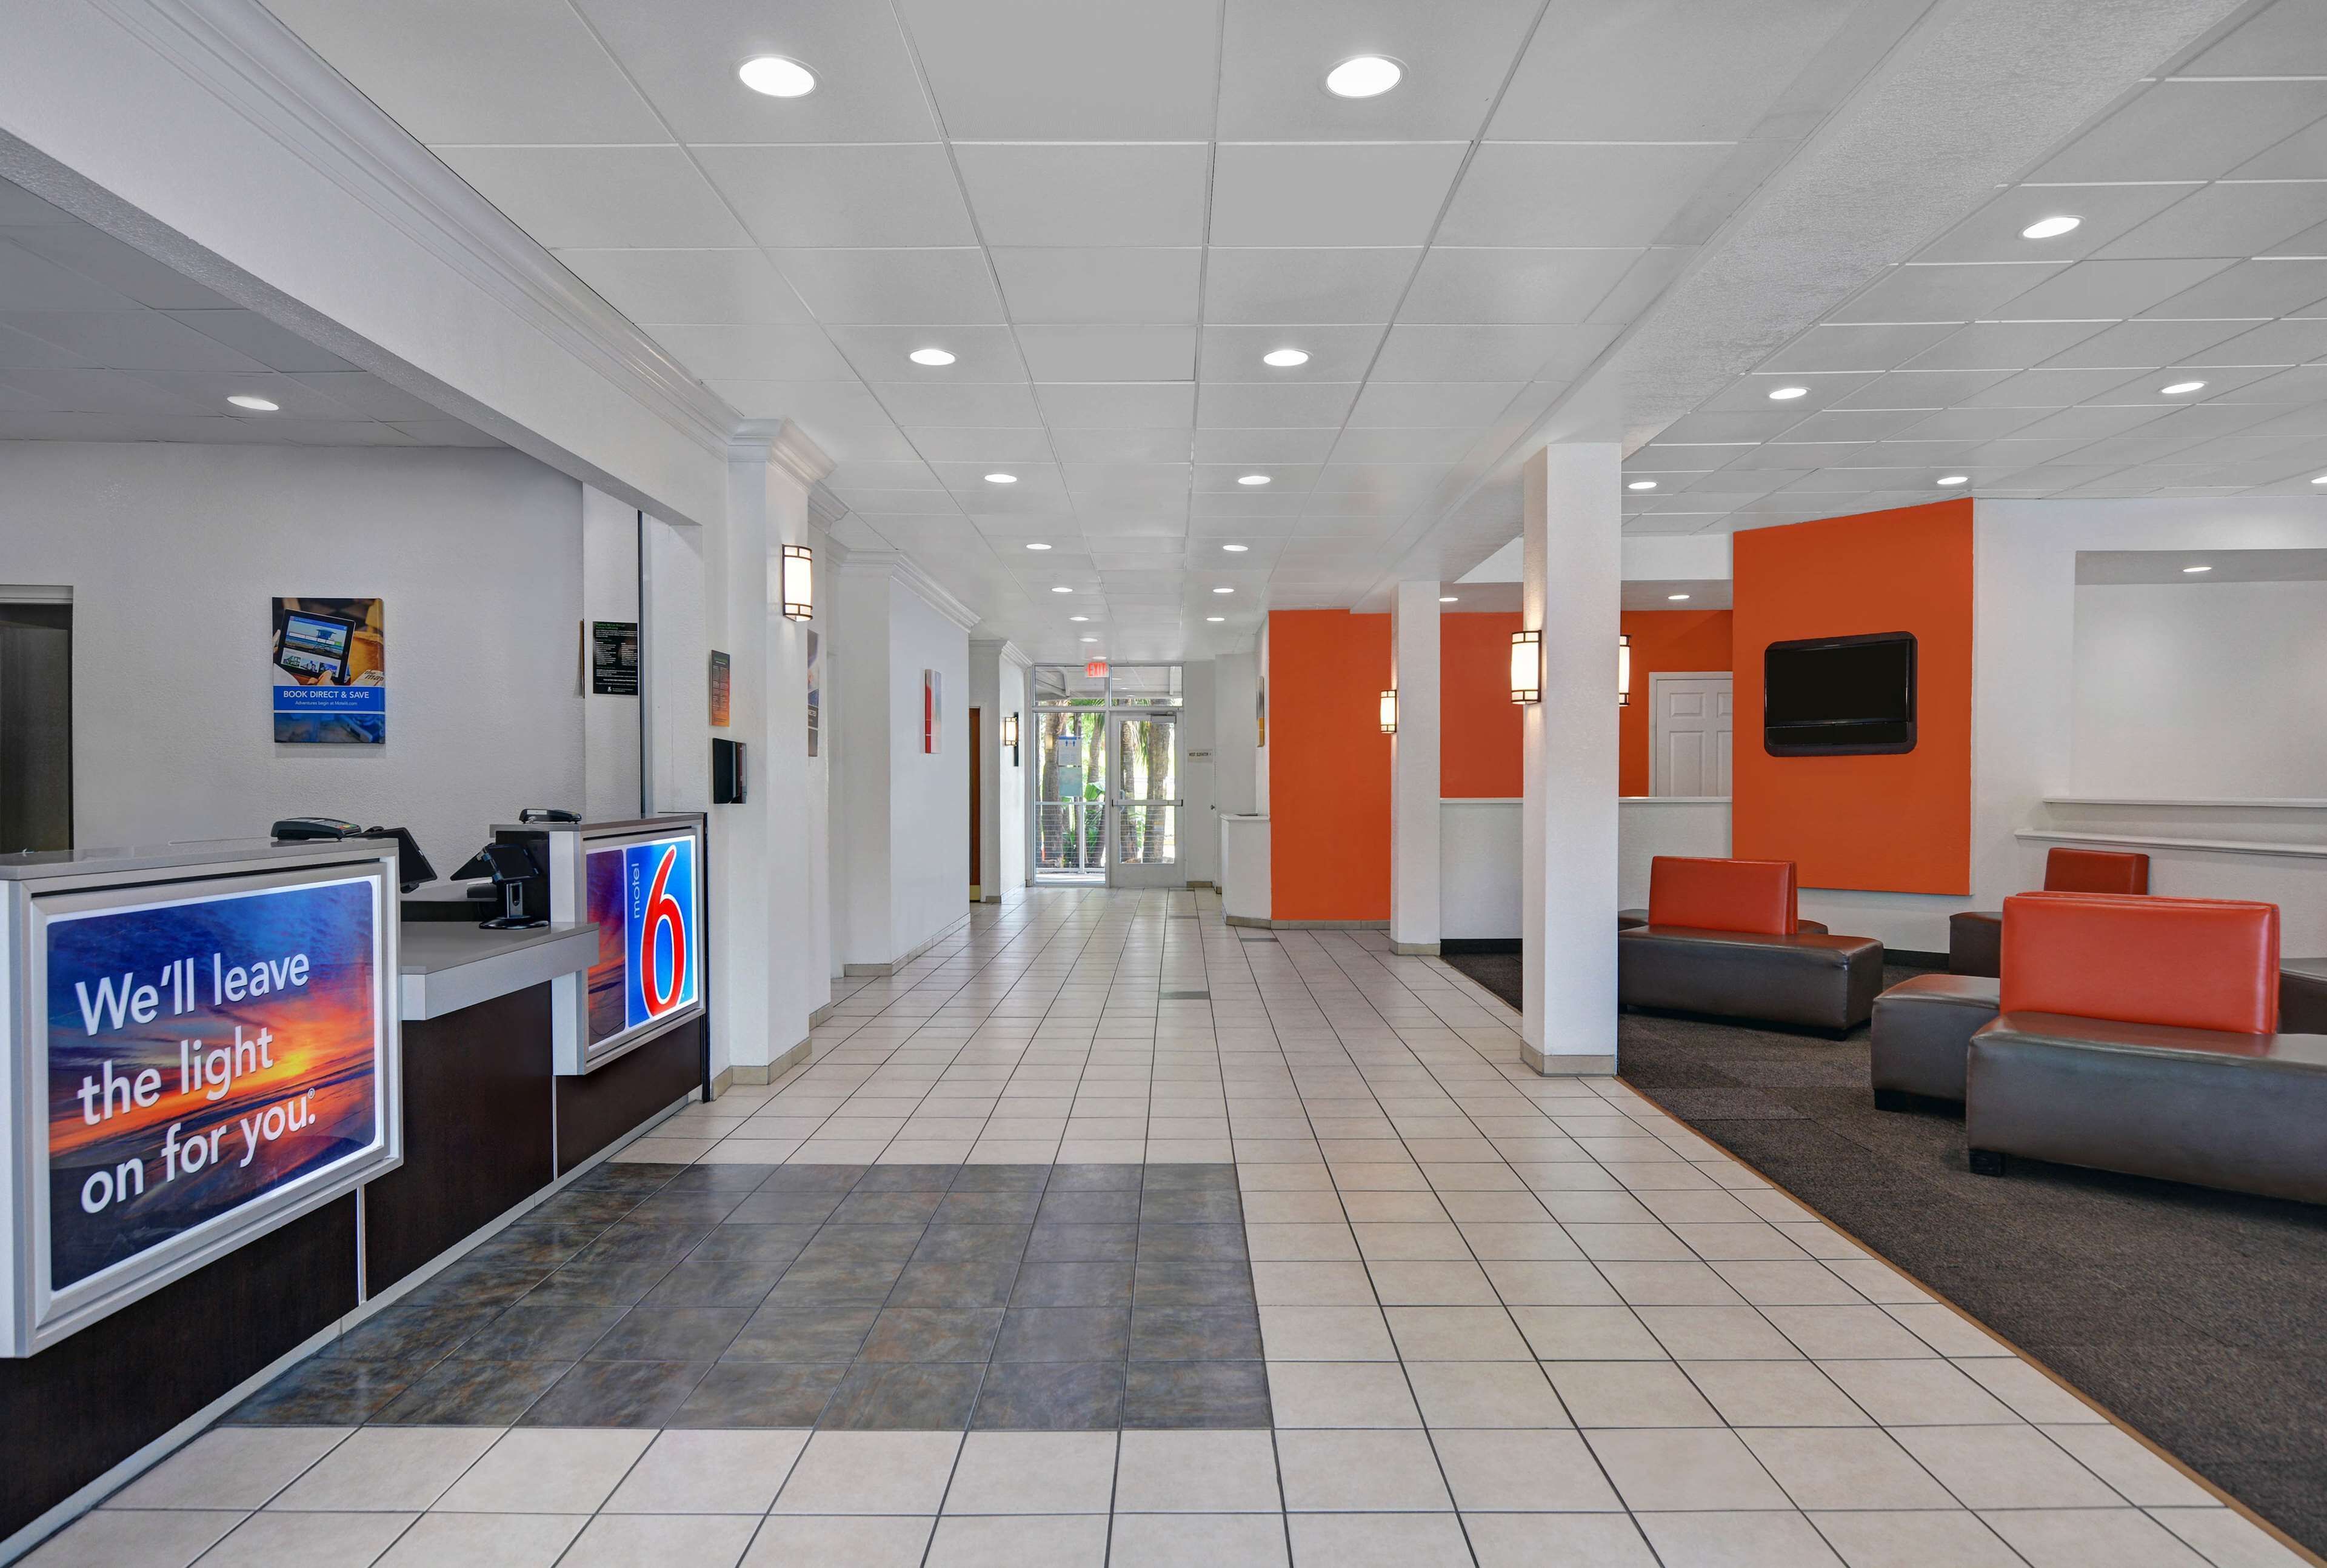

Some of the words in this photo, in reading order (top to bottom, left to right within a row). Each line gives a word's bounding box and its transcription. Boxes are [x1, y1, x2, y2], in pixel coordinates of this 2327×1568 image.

[1088, 662, 1106, 676] EXIT
[631, 862, 640, 919] motel
[640, 844, 686, 1019] 6
[75, 958, 195, 1037] We'll
[214, 953, 310, 1007] leave
[77, 1061, 162, 1126] the
[181, 1026, 273, 1101] light
[81, 1153, 144, 1214] on
[161, 1123, 227, 1183] for
